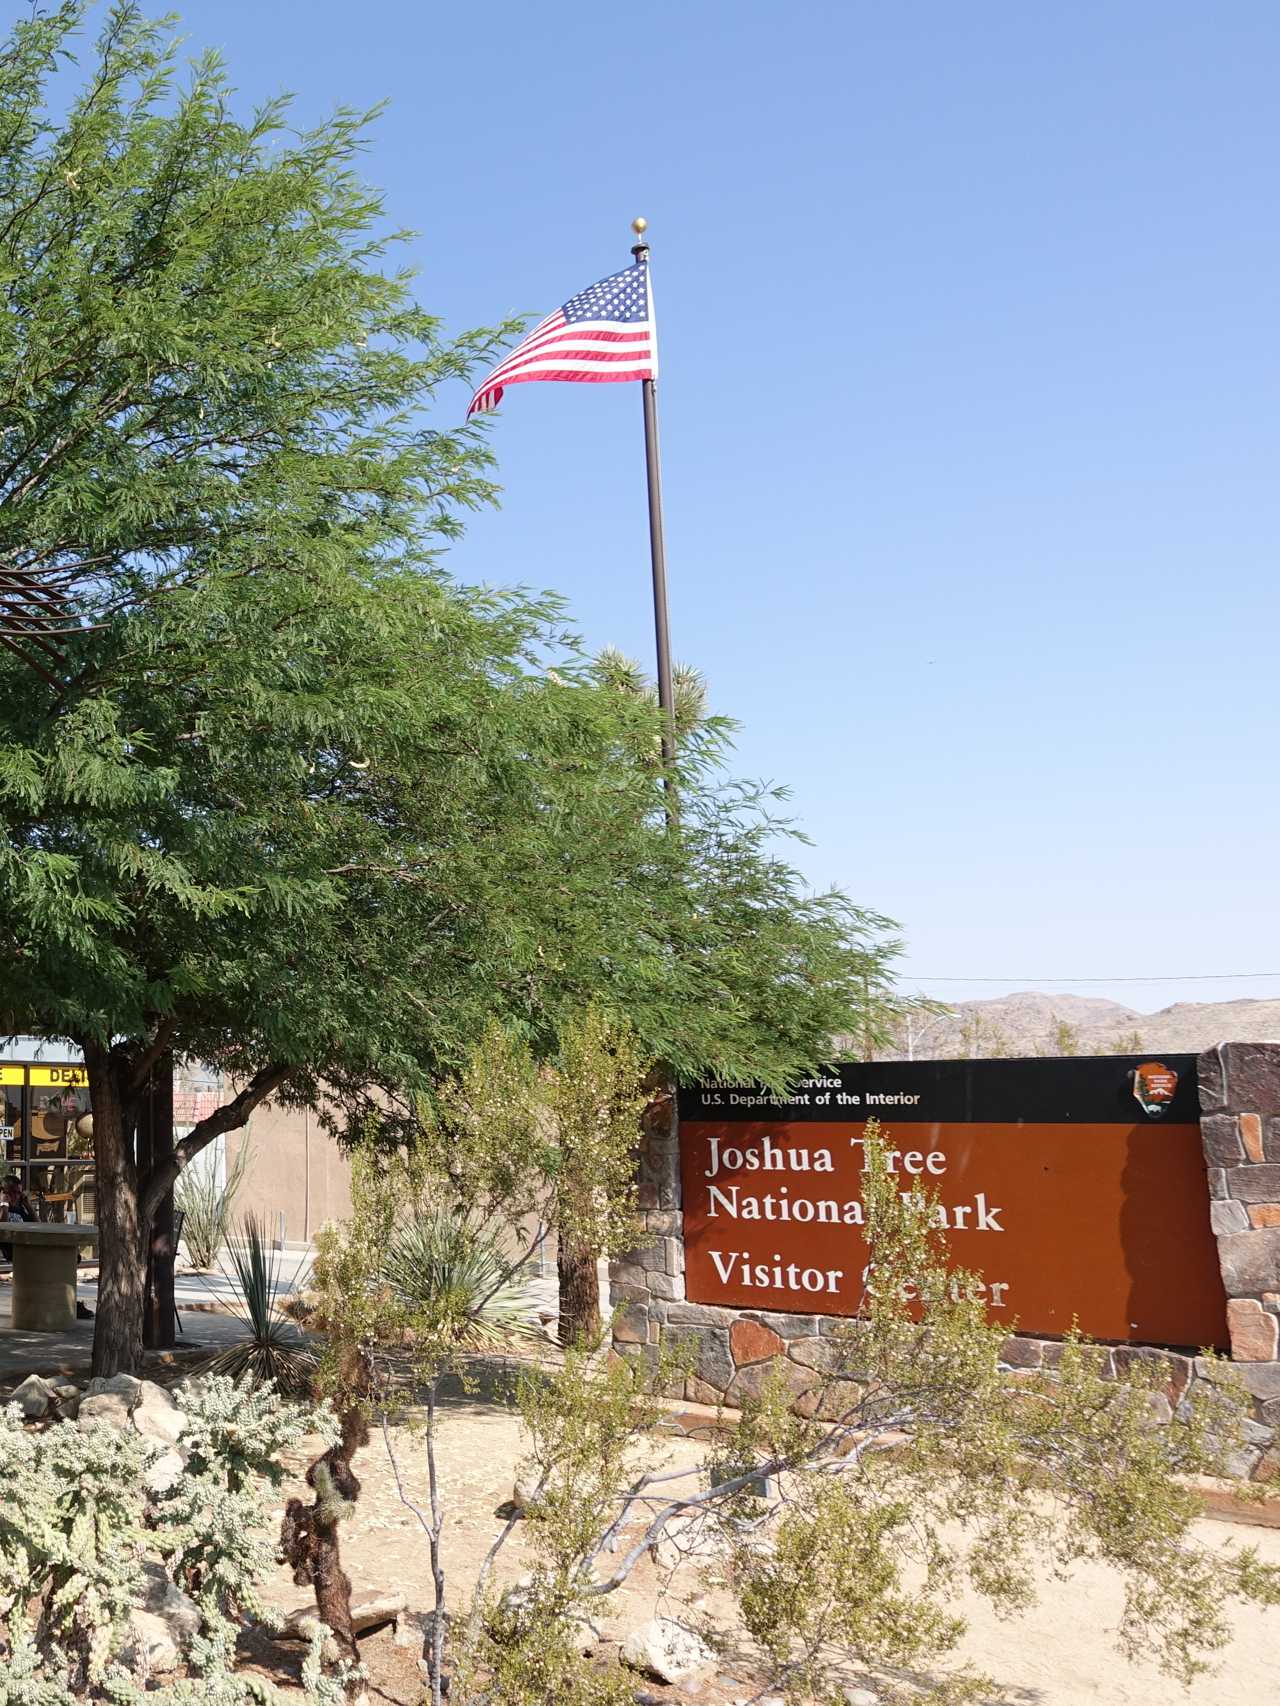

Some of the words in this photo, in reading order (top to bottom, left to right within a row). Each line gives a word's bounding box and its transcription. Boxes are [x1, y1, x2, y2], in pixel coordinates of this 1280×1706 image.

[50, 1069, 86, 1083] DELI
[701, 1093, 725, 1105] U.S.
[729, 1092, 811, 1108] Department
[815, 1092, 831, 1105] of
[836, 1092, 860, 1105] the
[866, 1092, 921, 1105] Interior
[705, 1136, 835, 1177] Joshua
[850, 1138, 947, 1175] Tree
[706, 1185, 866, 1225] Nationa
[708, 1251, 844, 1293] Visitor
[862, 1263, 1010, 1307] Ceter
